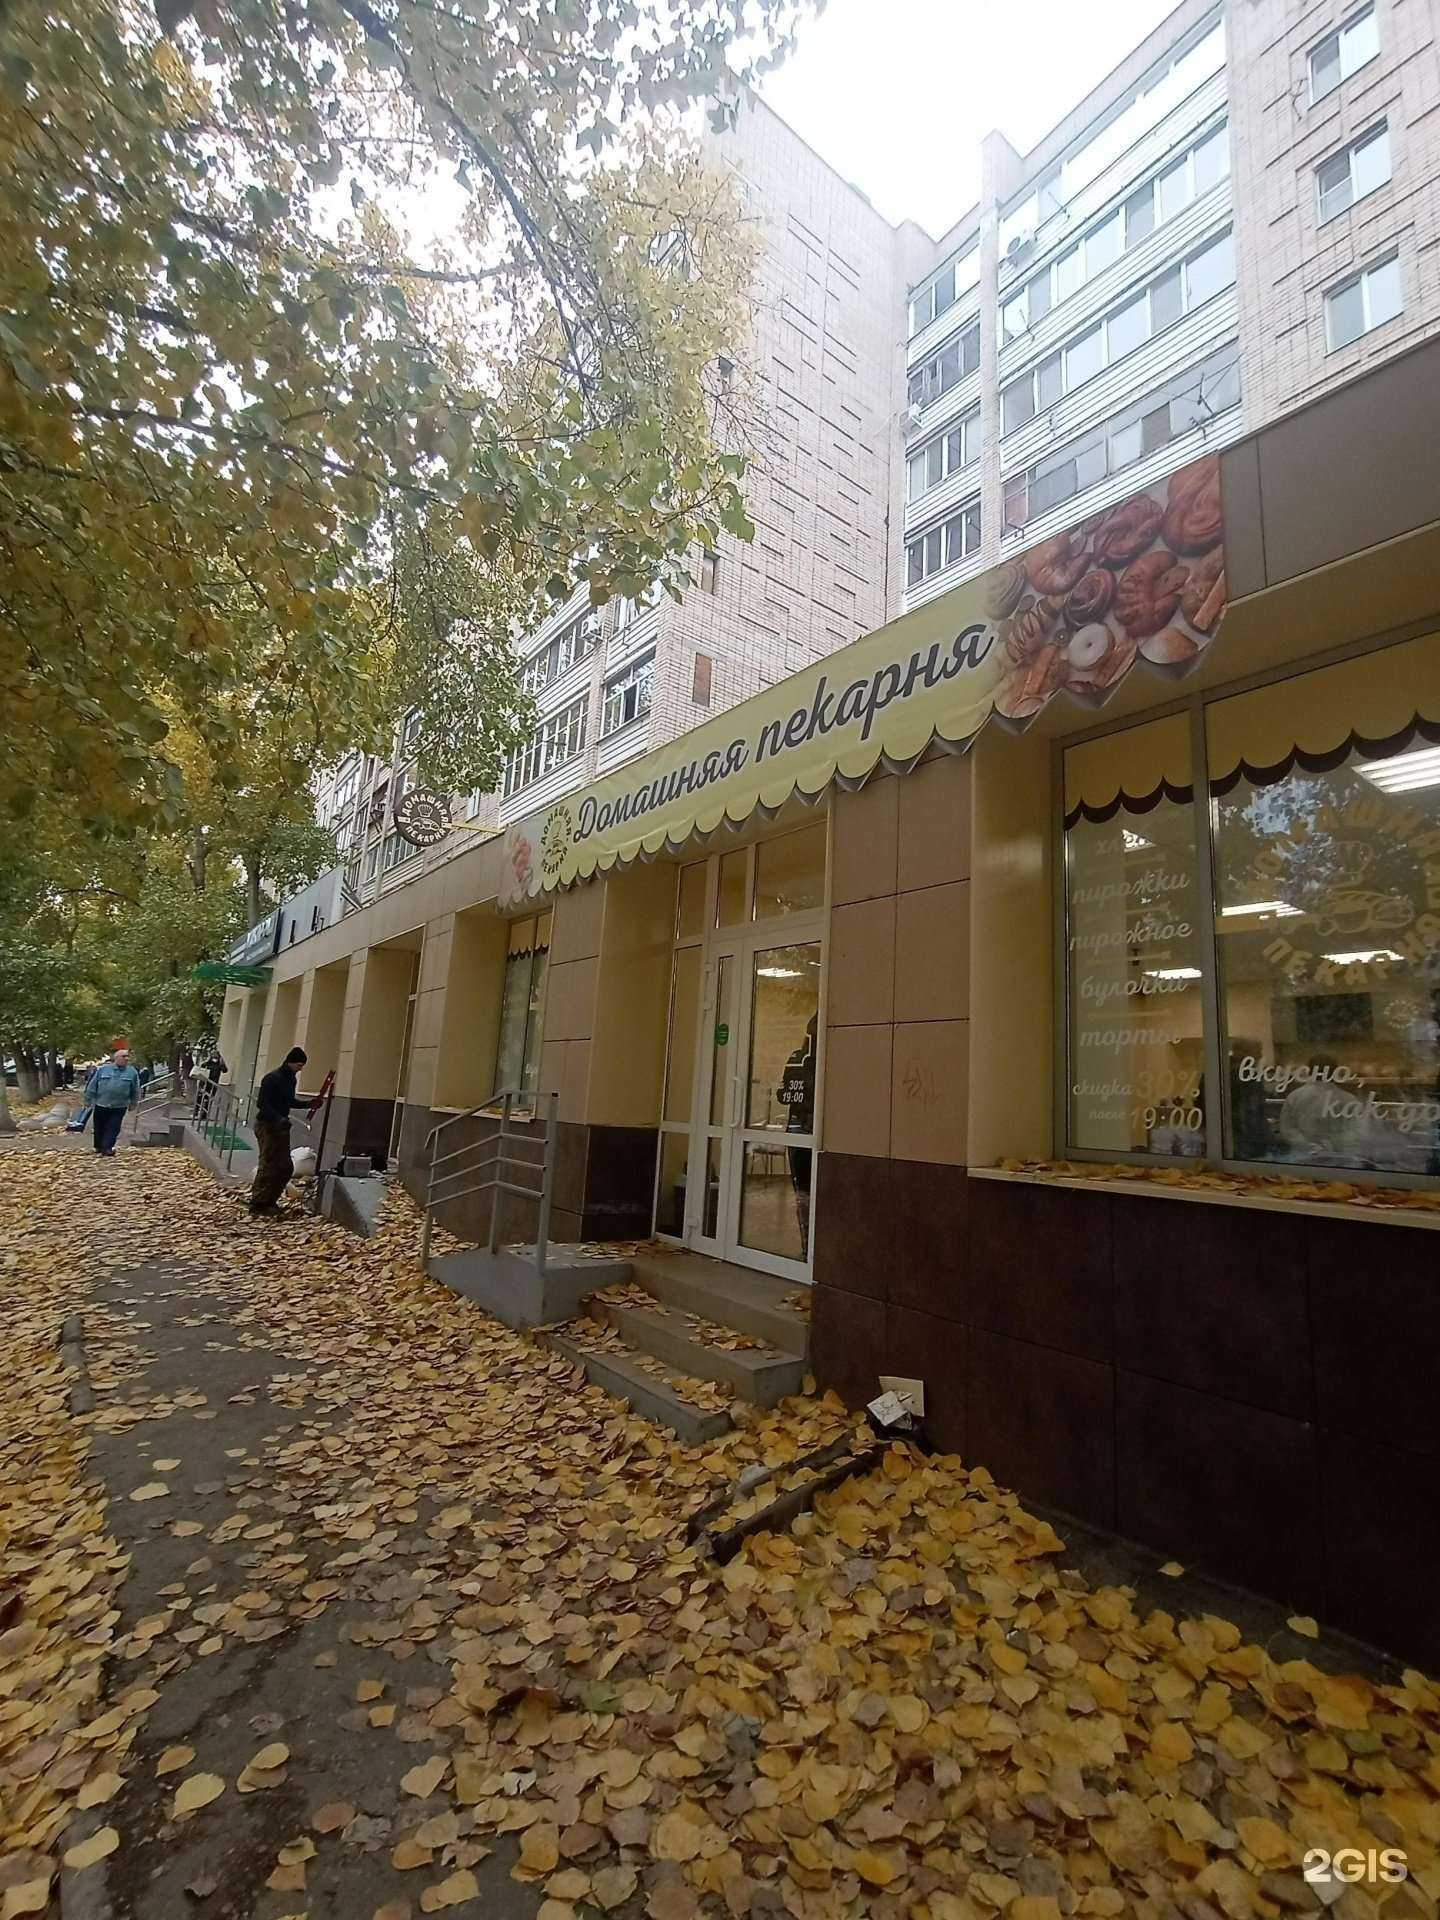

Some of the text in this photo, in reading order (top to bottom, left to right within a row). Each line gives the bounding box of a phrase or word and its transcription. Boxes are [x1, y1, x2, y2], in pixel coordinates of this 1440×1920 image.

[573, 623, 994, 843] Домашняя пекарня
[405, 826, 446, 843] ПЕКАРНЯ
[1072, 869, 1190, 910] пирожки
[1069, 920, 1193, 955] пирожное
[1080, 972, 1188, 1006] булочки
[1079, 1028, 1182, 1055] торты
[782, 1092, 804, 1103] 19:00
[789, 1080, 804, 1091] 30%
[1072, 1077, 1134, 1103] скидка
[1321, 1091, 1389, 1120] как
